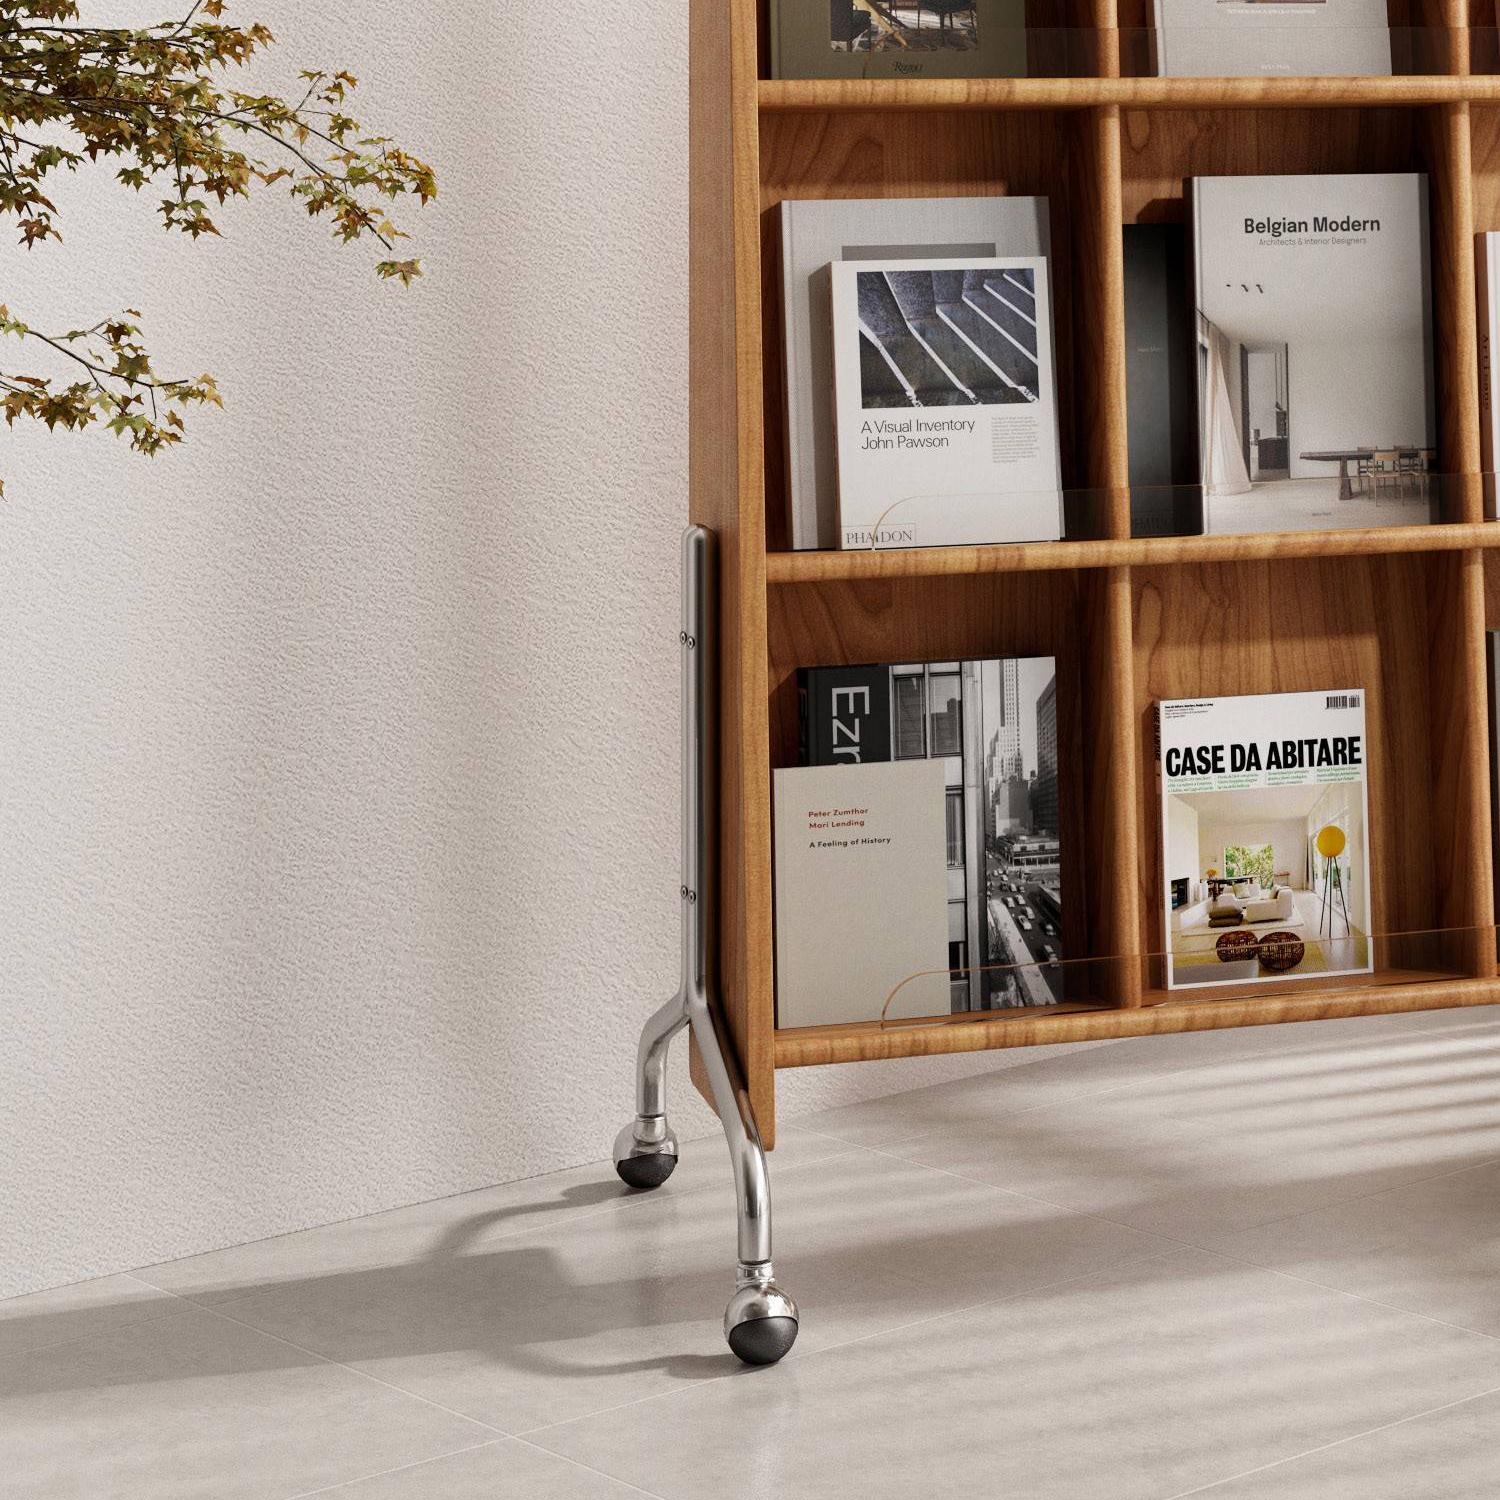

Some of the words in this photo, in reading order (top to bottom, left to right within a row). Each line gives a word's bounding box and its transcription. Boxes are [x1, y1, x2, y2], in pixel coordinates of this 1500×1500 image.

[1244, 216, 1308, 238] Belgian
[1312, 215, 1381, 233] Modern
[1258, 237, 1296, 246] Architects
[860, 420, 873, 434] A
[873, 419, 912, 433] Visual
[916, 419, 976, 435] Inventory
[861, 436, 894, 450] John
[897, 435, 949, 449] Pawson
[846, 530, 913, 544] PHAIDON
[831, 685, 870, 764] Ezr
[1165, 744, 1226, 777] CASE
[1230, 742, 1263, 773] DA
[1265, 735, 1362, 771] ABITARE
[808, 810, 831, 818] Peter
[833, 807, 869, 817] Zumthor
[831, 820, 865, 828] Lending
[809, 841, 815, 849] A
[817, 840, 848, 848] Feeling
[850, 838, 860, 846] of
[861, 837, 892, 845] History
